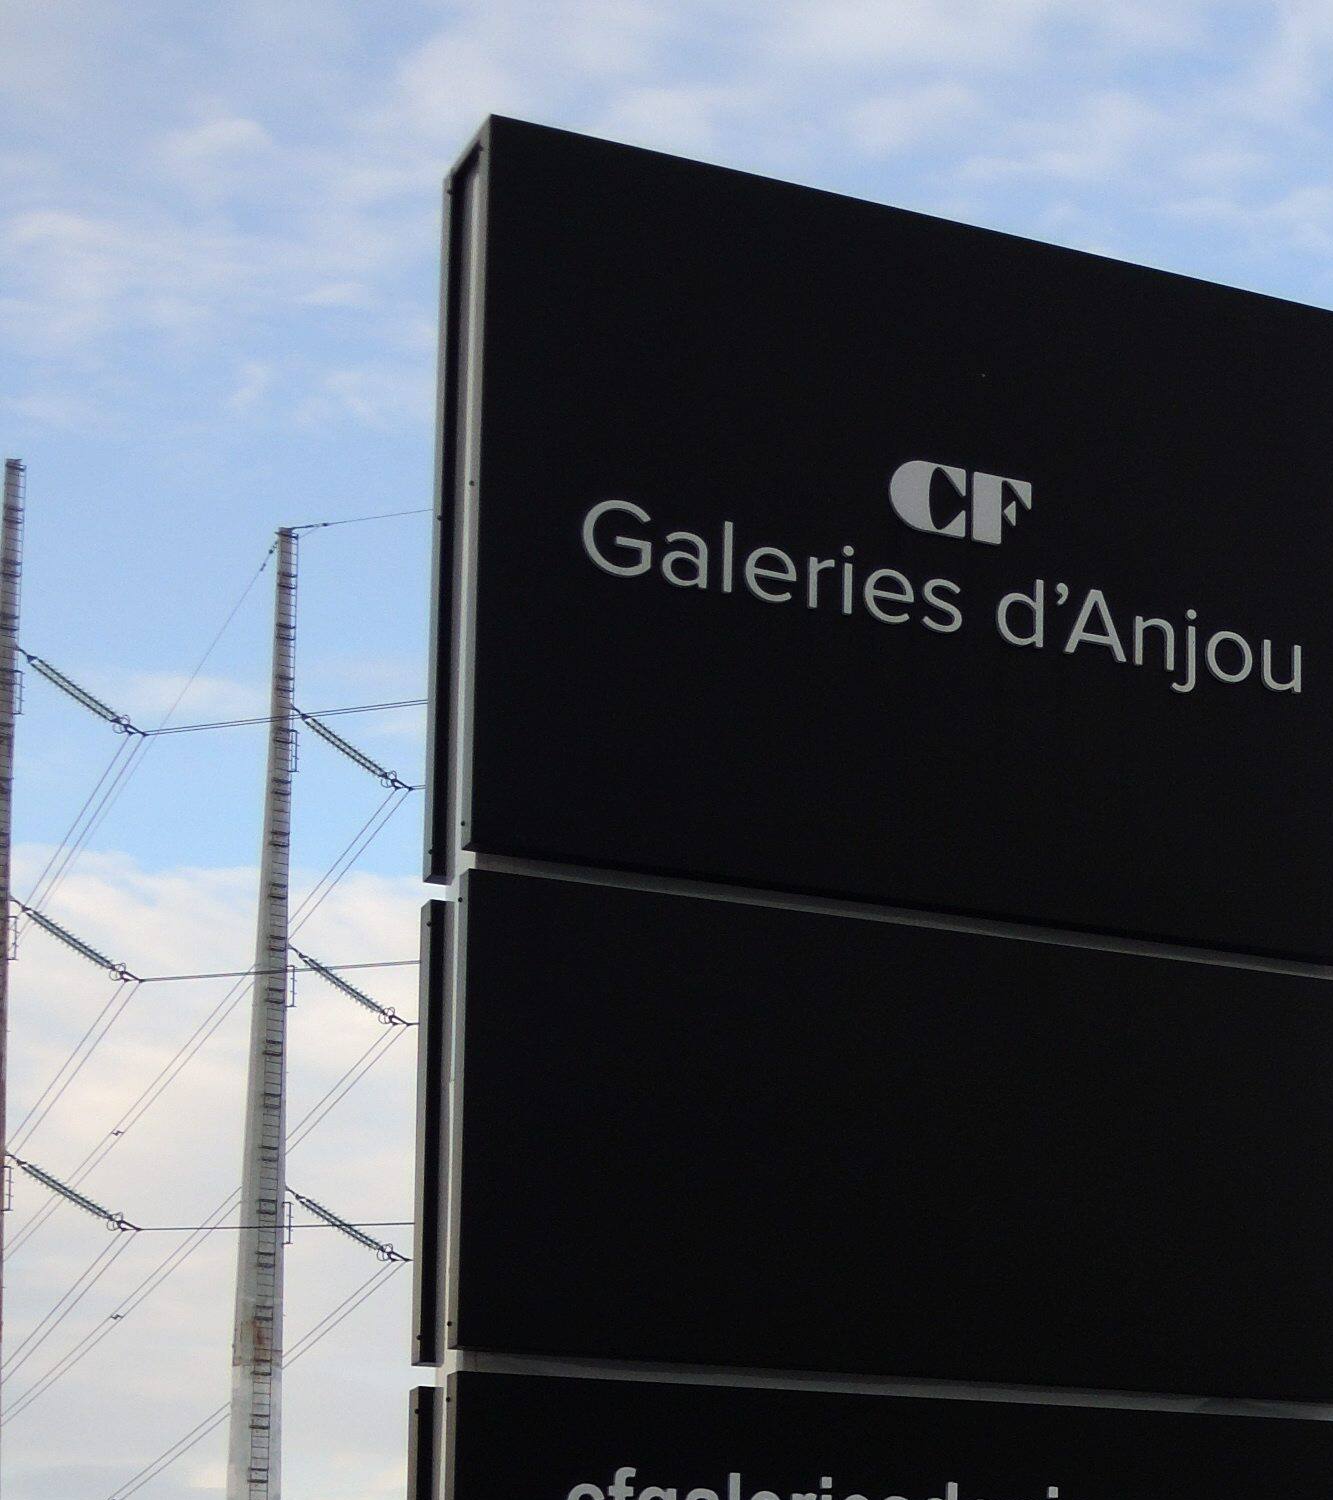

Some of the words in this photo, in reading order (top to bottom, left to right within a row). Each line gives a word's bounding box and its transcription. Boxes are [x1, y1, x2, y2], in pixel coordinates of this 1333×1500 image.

[889, 460, 1032, 545] CF
[581, 498, 964, 634] Galeries
[996, 579, 1303, 694] d'Anjou
